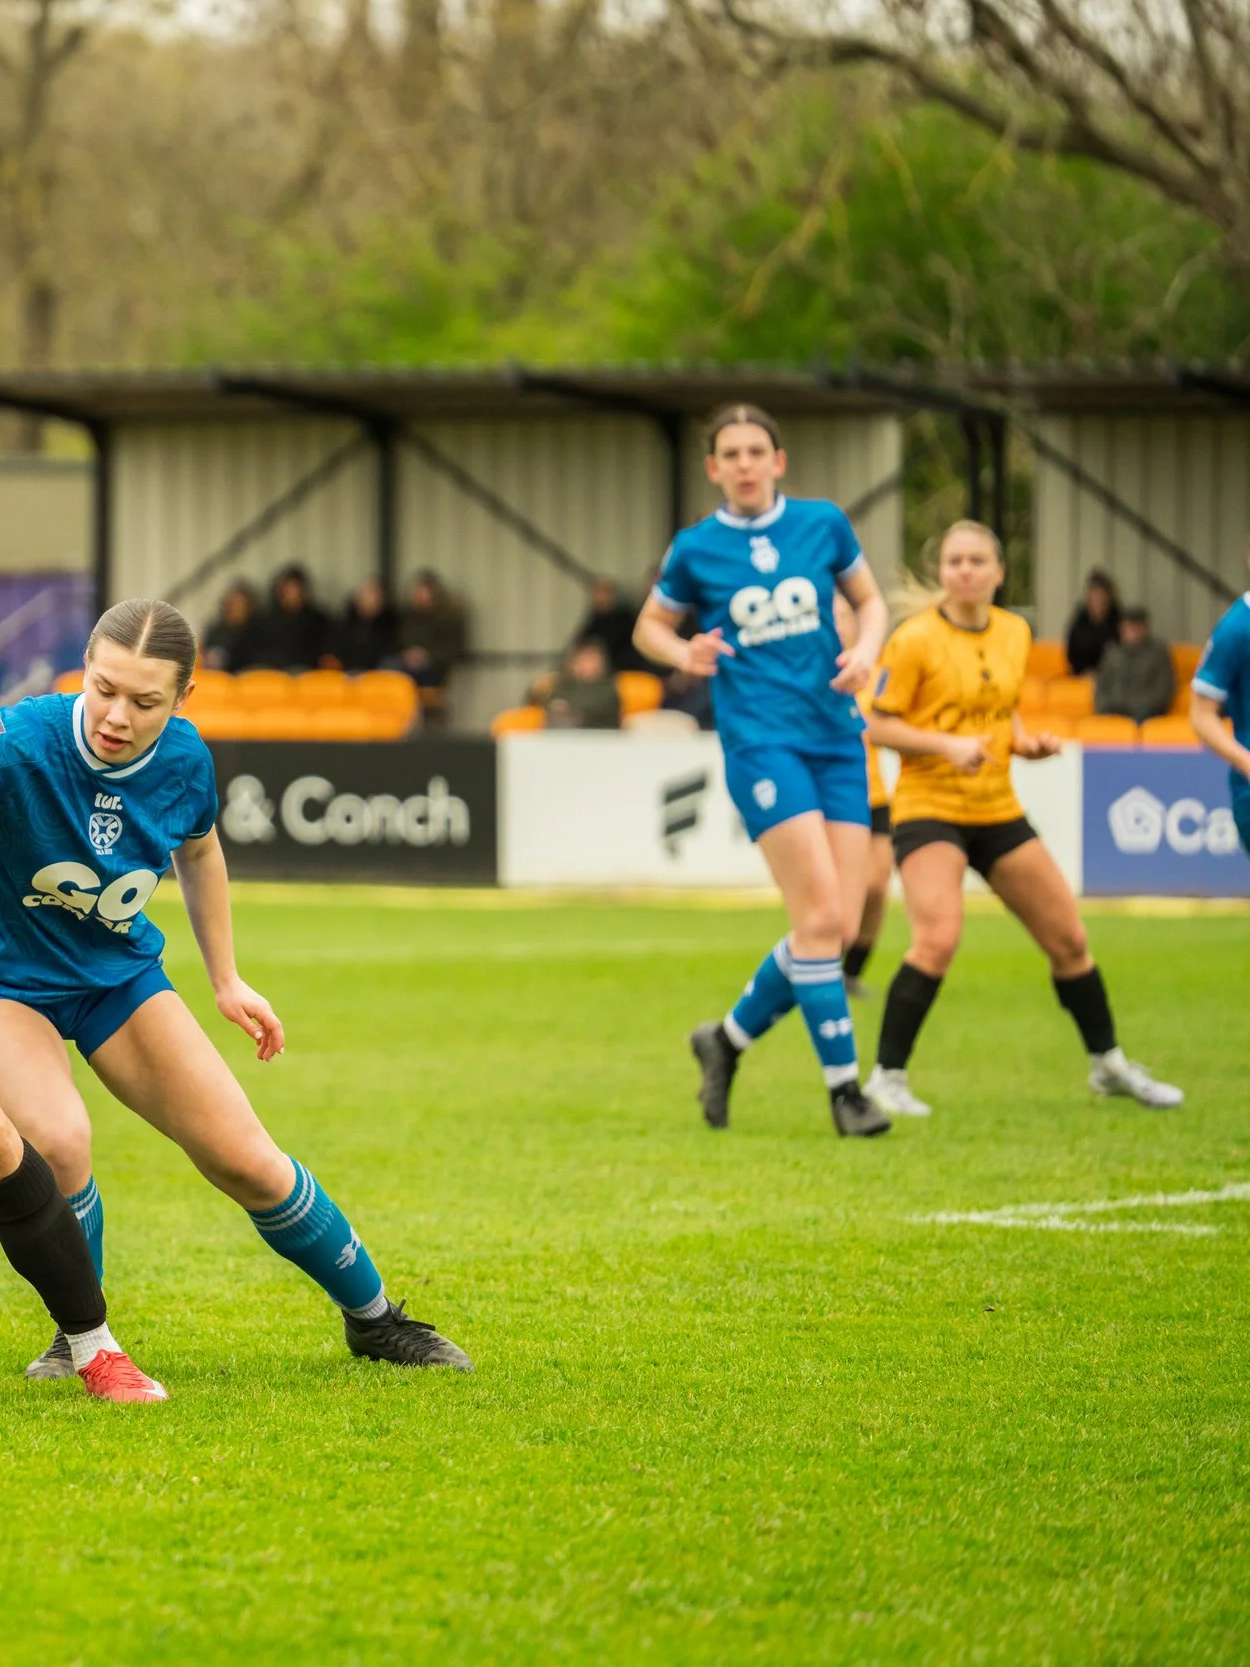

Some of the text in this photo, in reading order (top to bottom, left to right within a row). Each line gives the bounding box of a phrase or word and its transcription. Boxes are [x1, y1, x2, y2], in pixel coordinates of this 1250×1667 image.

[222, 773, 470, 846] & Conch
[31, 861, 159, 921] GO
